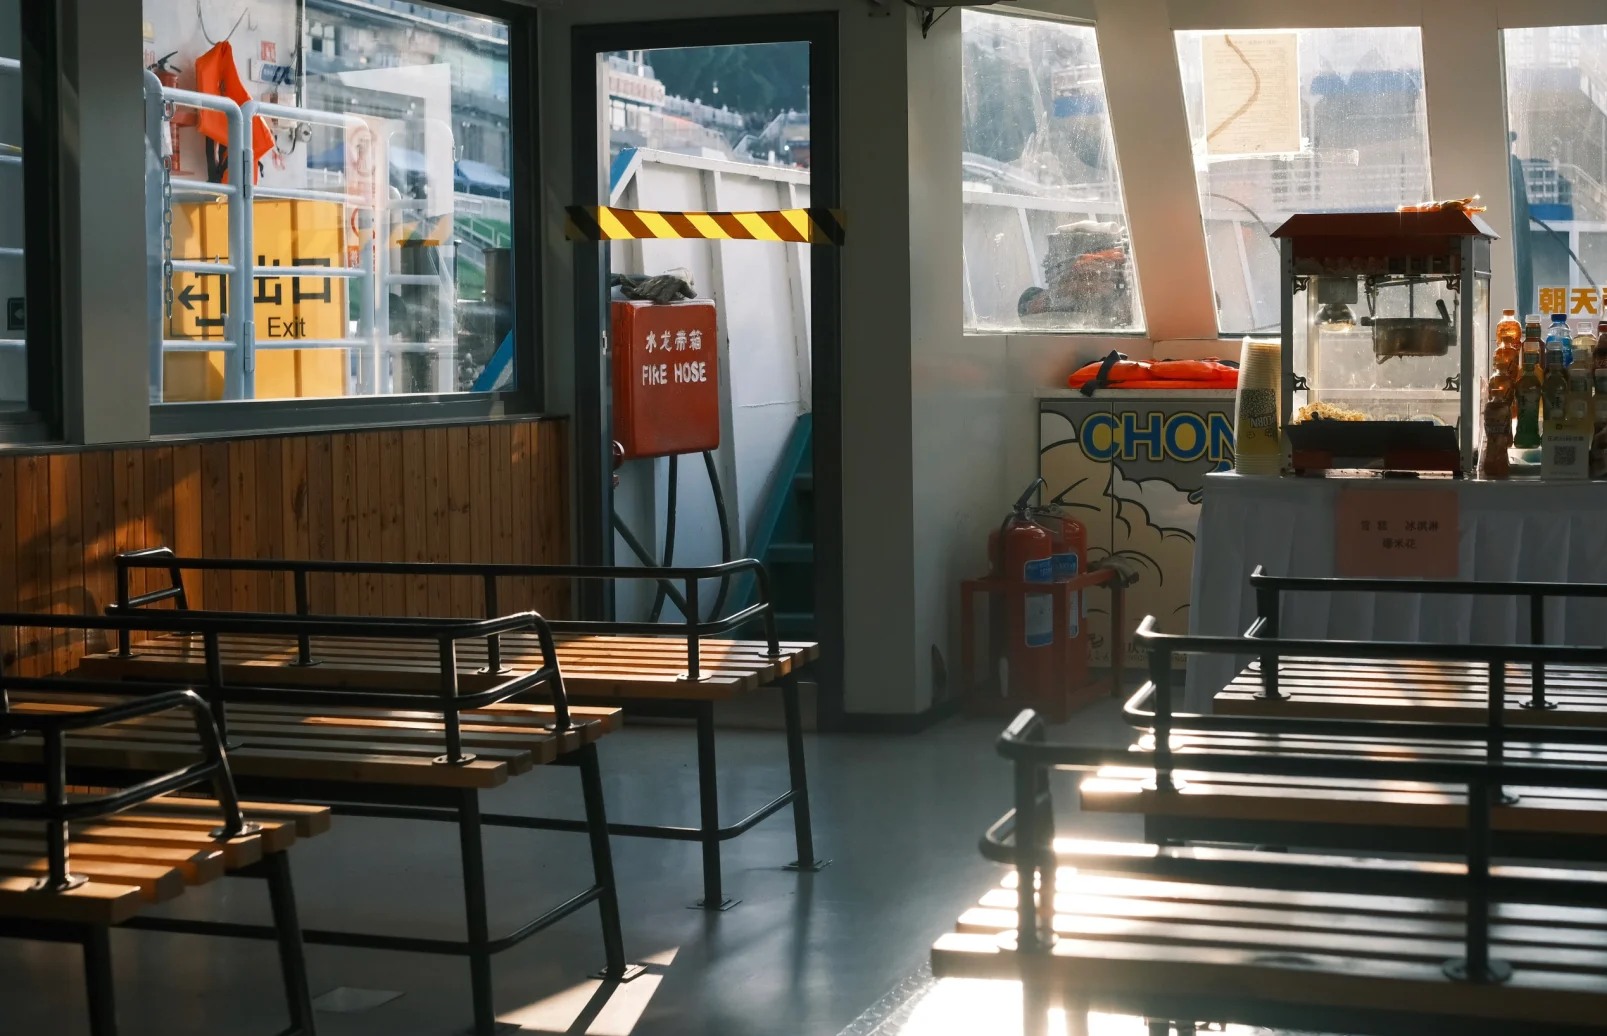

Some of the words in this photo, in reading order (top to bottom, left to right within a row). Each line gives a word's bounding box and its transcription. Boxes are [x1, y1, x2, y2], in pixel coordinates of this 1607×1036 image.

[253, 255, 331, 305] 出口
[1538, 287, 1607, 315] 朝天
[268, 316, 306, 338] Exit
[645, 329, 703, 353] 水龙带箱
[642, 363, 668, 386] FIRE
[674, 361, 707, 384] HOSE
